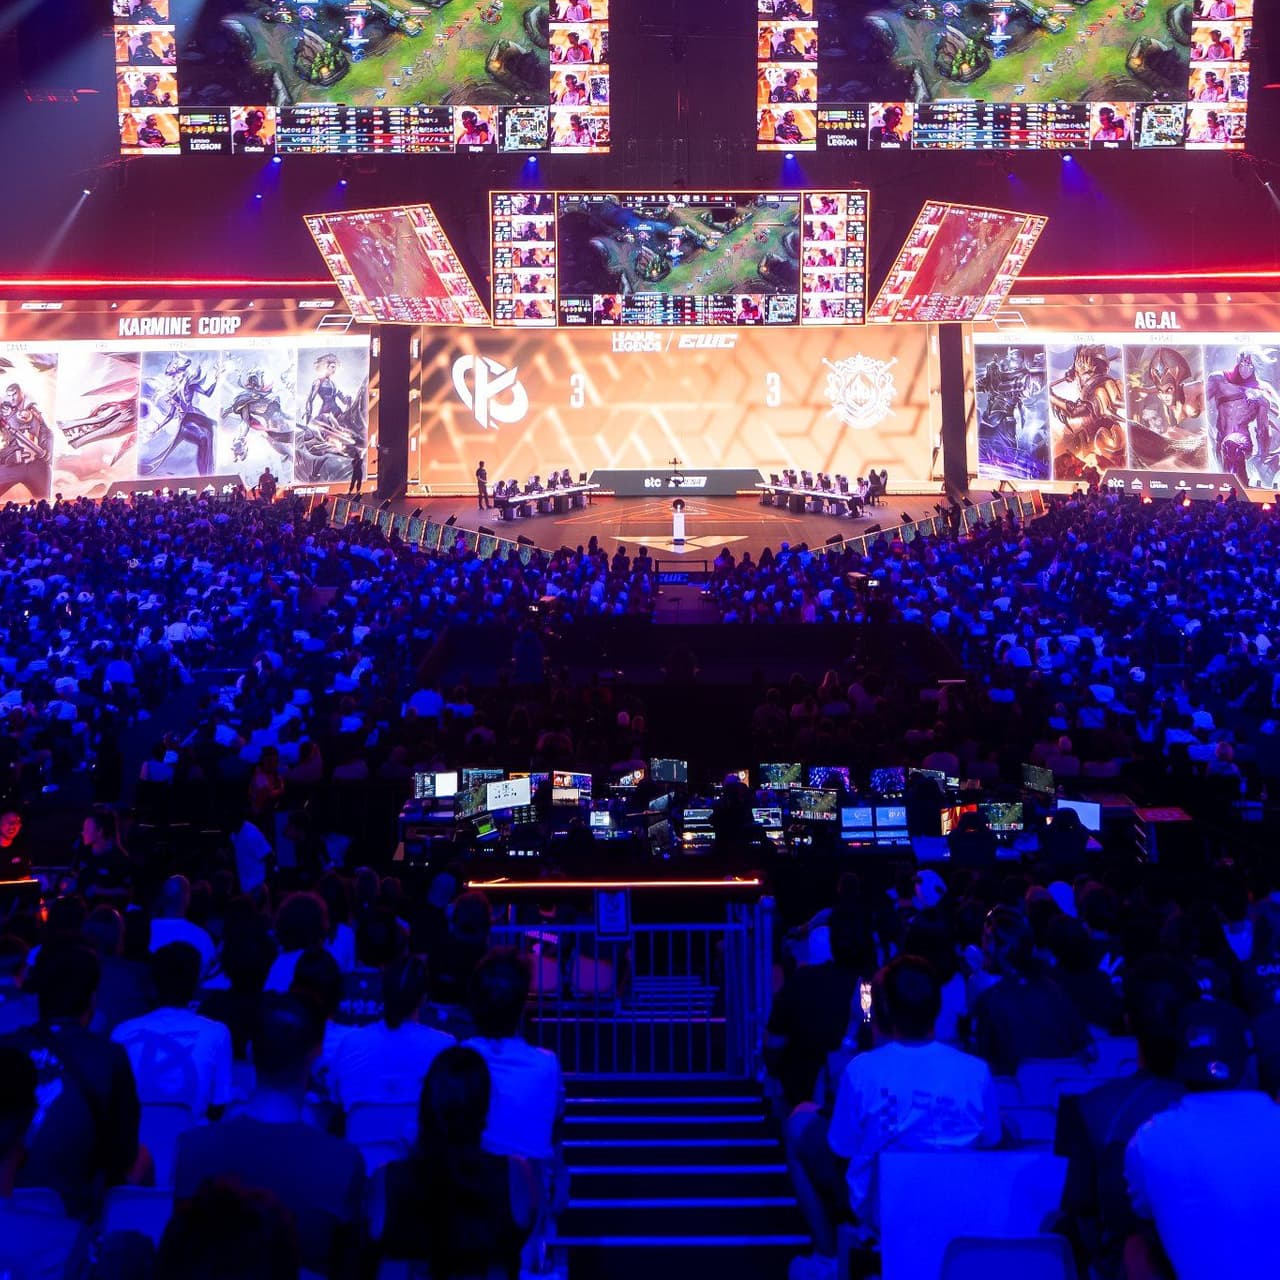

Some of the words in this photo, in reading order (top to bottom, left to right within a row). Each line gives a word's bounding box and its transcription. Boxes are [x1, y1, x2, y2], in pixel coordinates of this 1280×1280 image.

[119, 316, 191, 336] KARMINE
[198, 316, 241, 335] CORP
[1134, 311, 1180, 330] AG.AL
[678, 333, 738, 349] EWC
[570, 375, 585, 408] 3
[766, 372, 781, 408] 3
